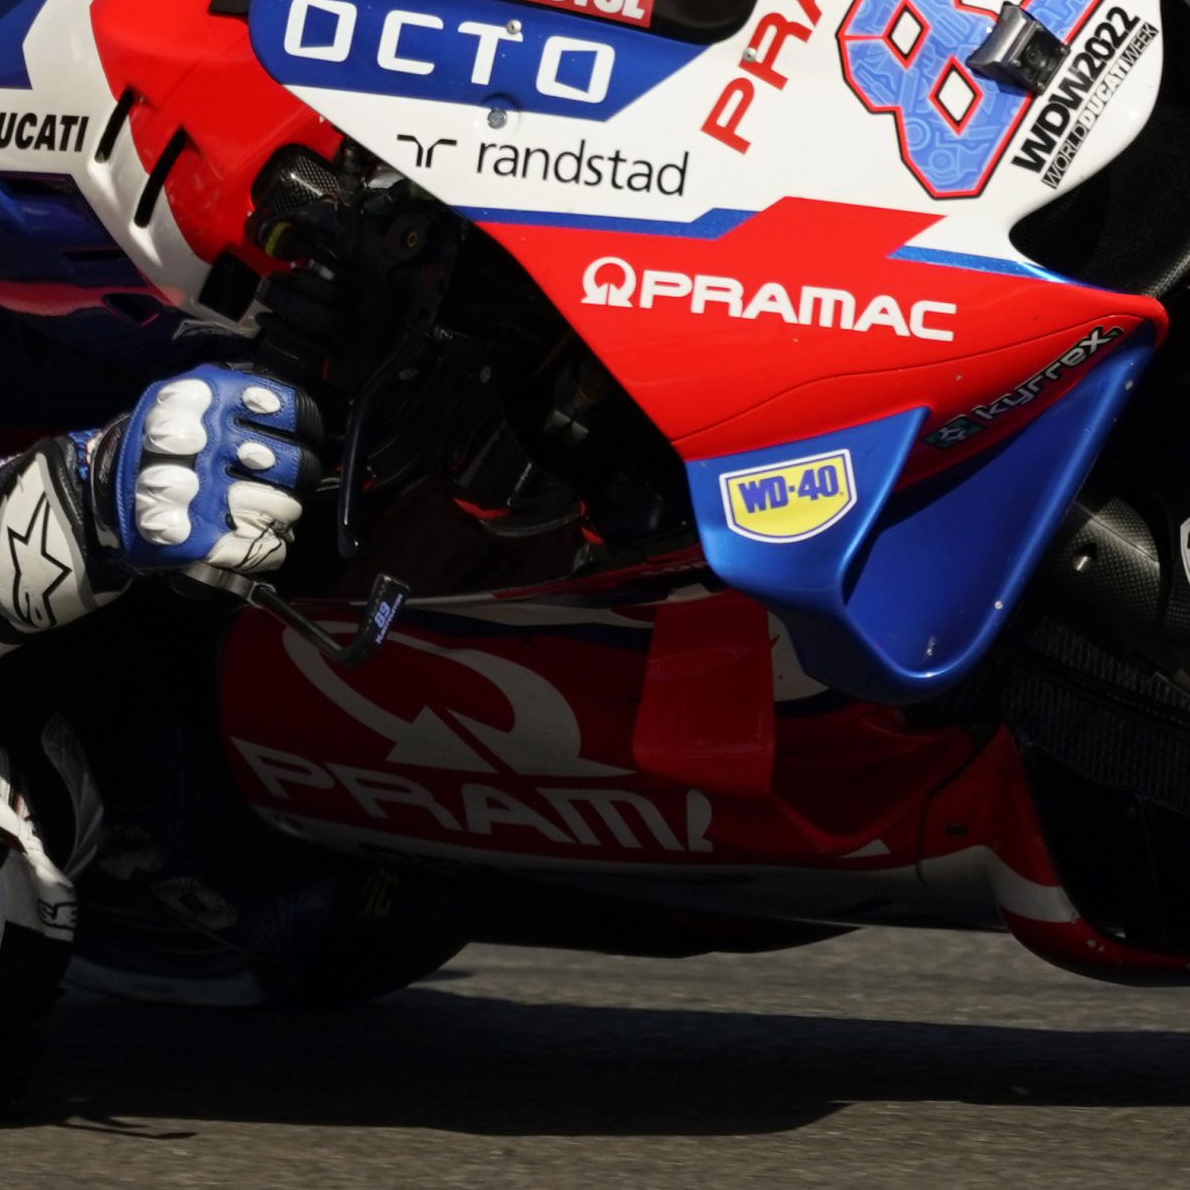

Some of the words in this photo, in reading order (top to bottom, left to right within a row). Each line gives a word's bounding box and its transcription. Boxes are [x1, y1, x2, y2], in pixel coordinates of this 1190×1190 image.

[1011, 6, 1141, 173] WDW2022
[476, 138, 690, 197] randstad
[639, 270, 957, 342] PRAMAC
[974, 329, 1112, 421] kyrrex
[738, 464, 839, 515] WD-40
[230, 735, 715, 854] PRAM
